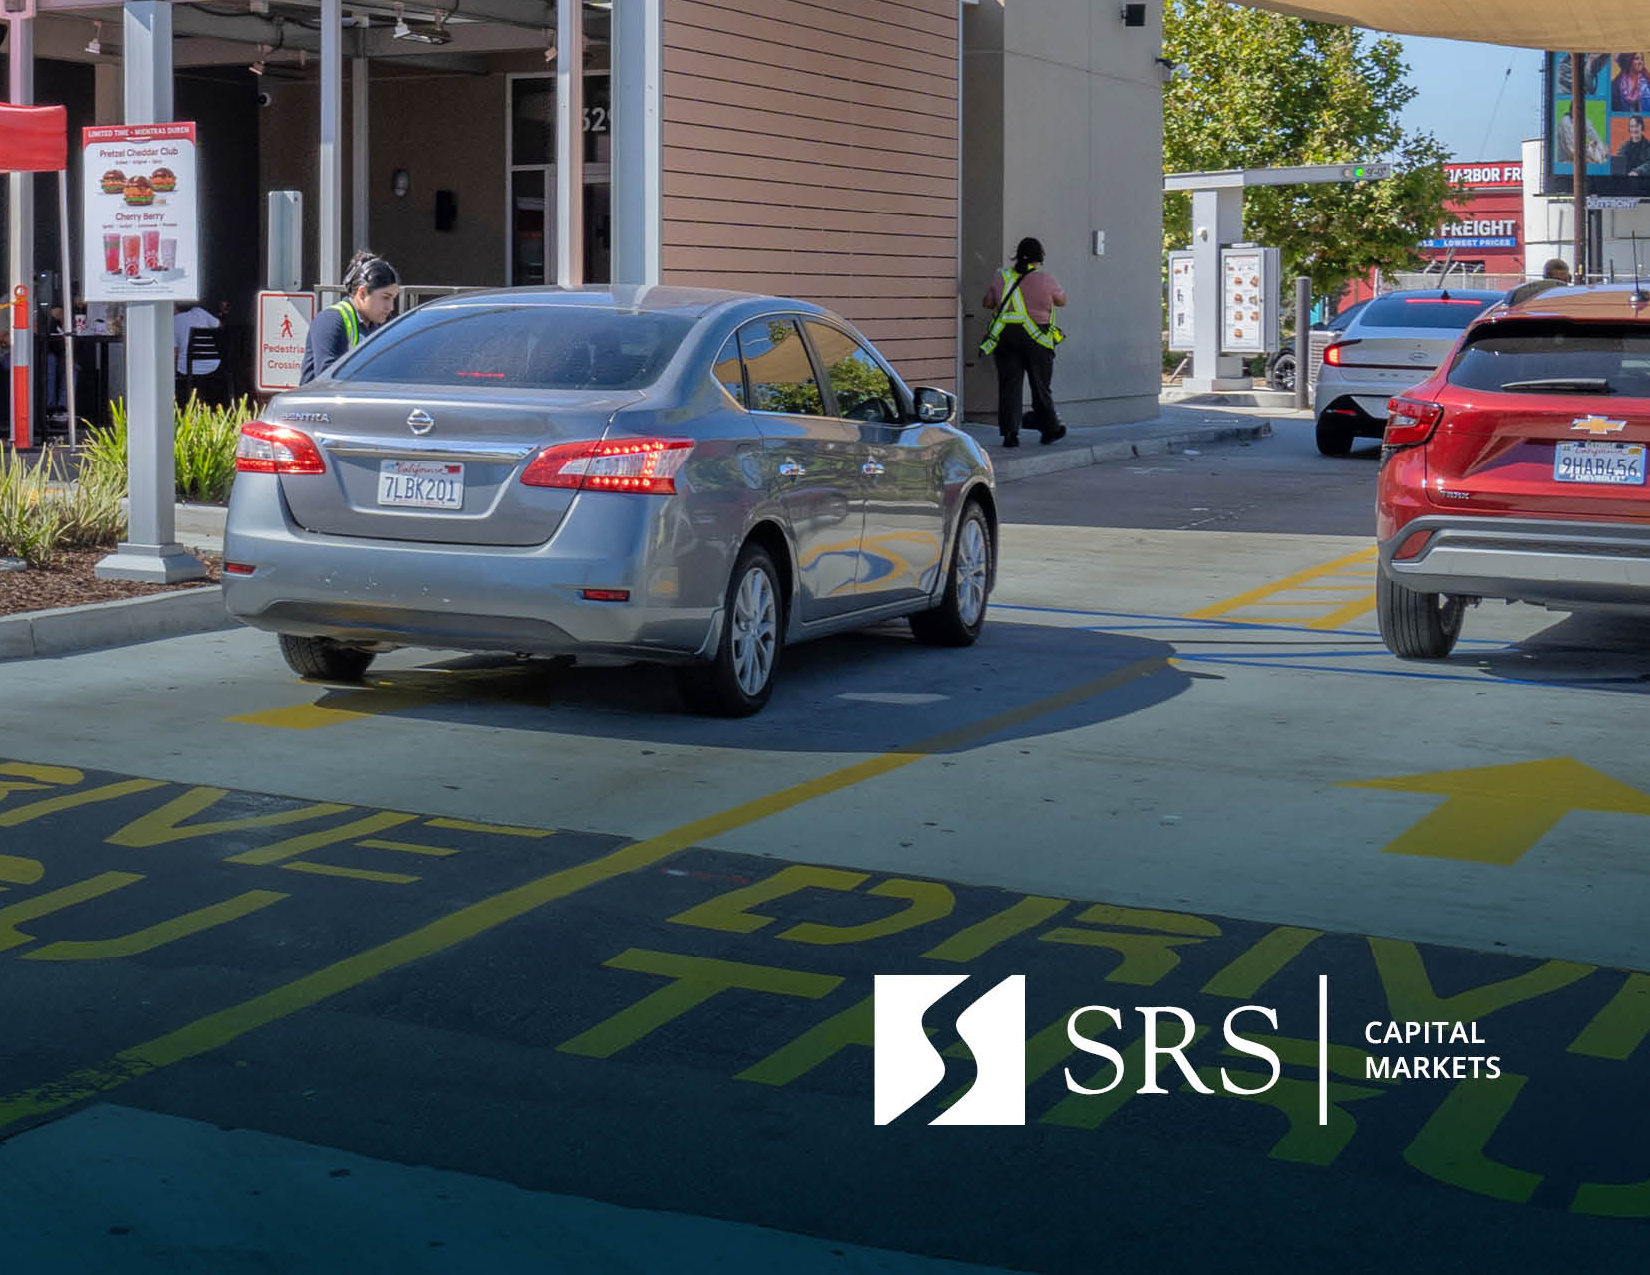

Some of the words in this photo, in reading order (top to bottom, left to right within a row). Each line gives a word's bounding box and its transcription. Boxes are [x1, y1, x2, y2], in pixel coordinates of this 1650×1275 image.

[88, 129, 114, 137] LIMITED
[99, 149, 125, 157] Pretzel
[127, 148, 159, 157] Cheddar
[160, 147, 179, 155] Club
[115, 213, 142, 221] Cherry
[143, 212, 165, 221] Berry
[263, 343, 305, 354] Pedestria
[267, 359, 301, 370] Crossin
[1562, 456, 1640, 477] 9HAB456
[385, 476, 456, 502] 7LBK201
